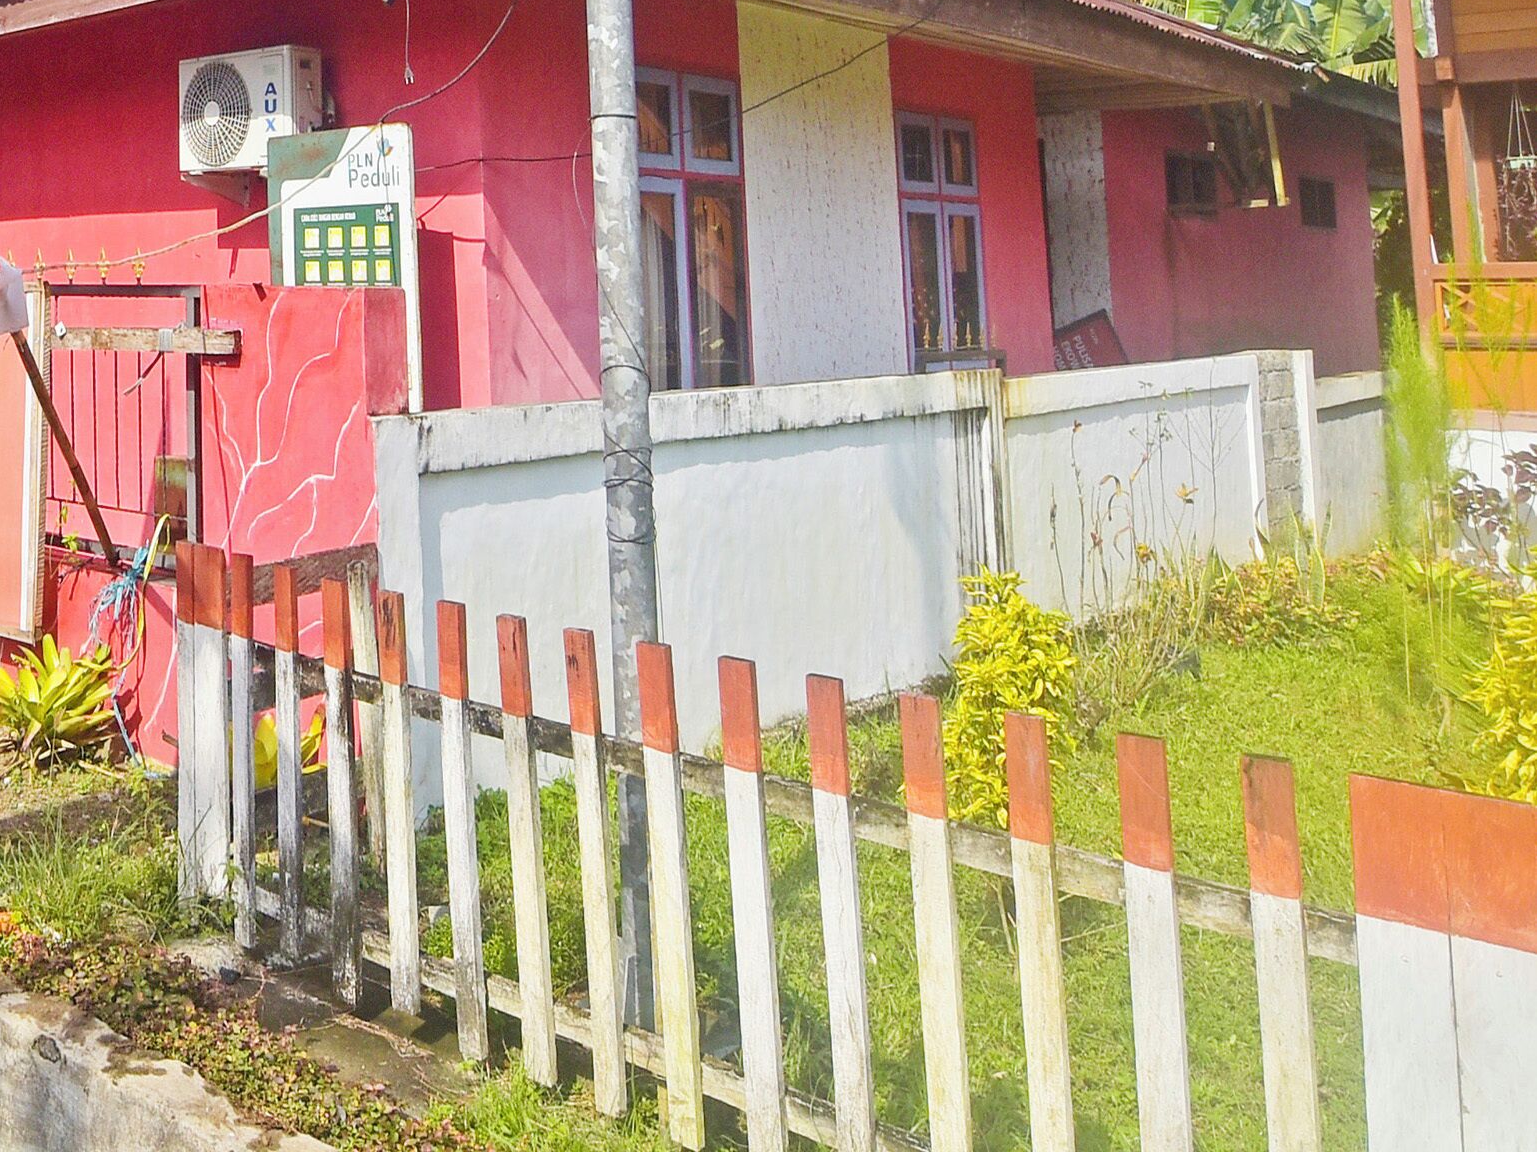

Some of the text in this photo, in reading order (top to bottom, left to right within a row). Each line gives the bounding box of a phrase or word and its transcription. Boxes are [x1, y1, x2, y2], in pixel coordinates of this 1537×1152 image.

[264, 82, 278, 133] AUX
[348, 153, 373, 168] PLN
[348, 164, 400, 189] Peduli
